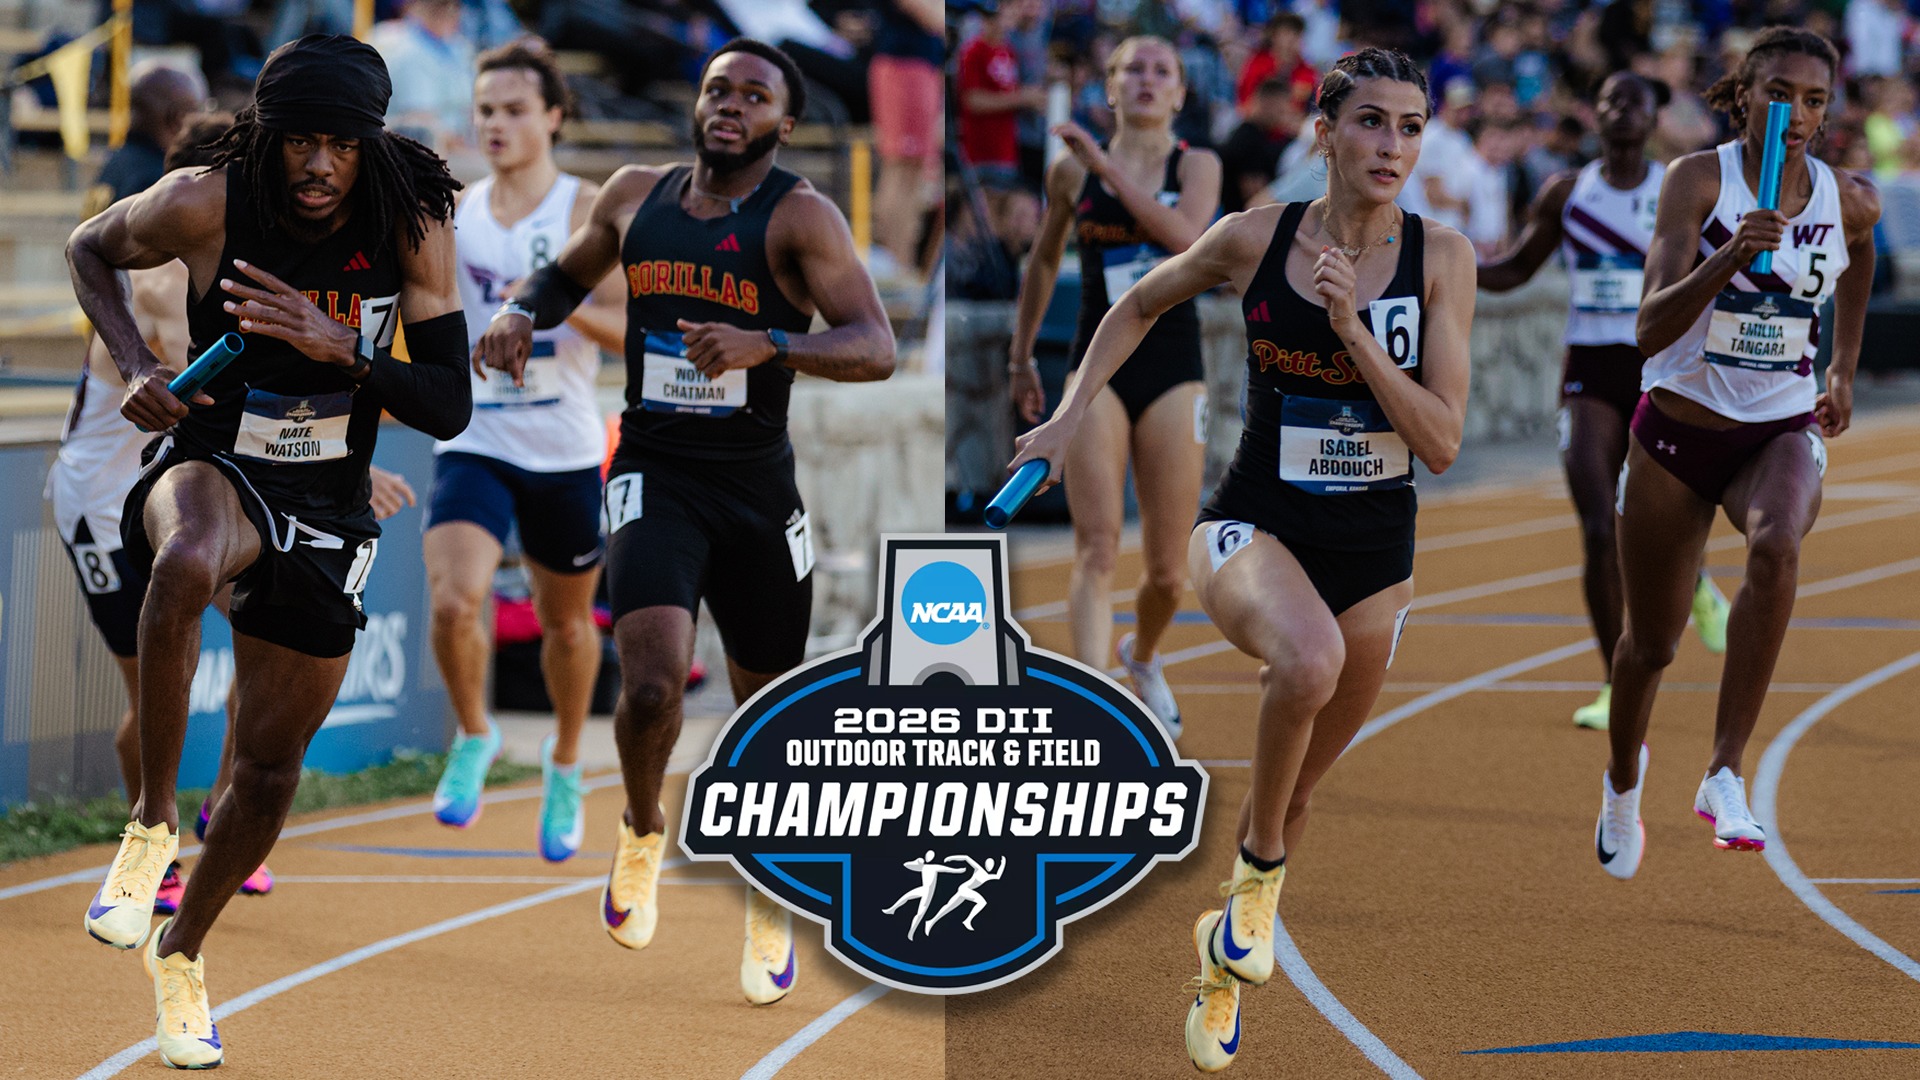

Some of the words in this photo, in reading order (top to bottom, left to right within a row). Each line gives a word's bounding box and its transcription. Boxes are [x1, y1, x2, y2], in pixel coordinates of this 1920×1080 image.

[531, 234, 549, 270] 8
[1793, 224, 1834, 248] WT
[627, 260, 759, 315] GORILLAS
[1801, 252, 1826, 298] 5
[371, 302, 394, 345] 7
[1385, 304, 1411, 366] 6
[1253, 339, 1322, 376] Pitt
[1730, 337, 1785, 356] TANGARA
[663, 383, 726, 401] CHATMAN
[264, 440, 321, 458] WATSON
[279, 426, 313, 441] NATE
[1320, 438, 1373, 457] ISABEL
[1308, 458, 1384, 477] ABDOUCH
[612, 478, 631, 523] 7
[795, 524, 808, 573] 7
[1217, 521, 1241, 559] 6
[84, 551, 109, 588] 8
[353, 541, 373, 591] 7
